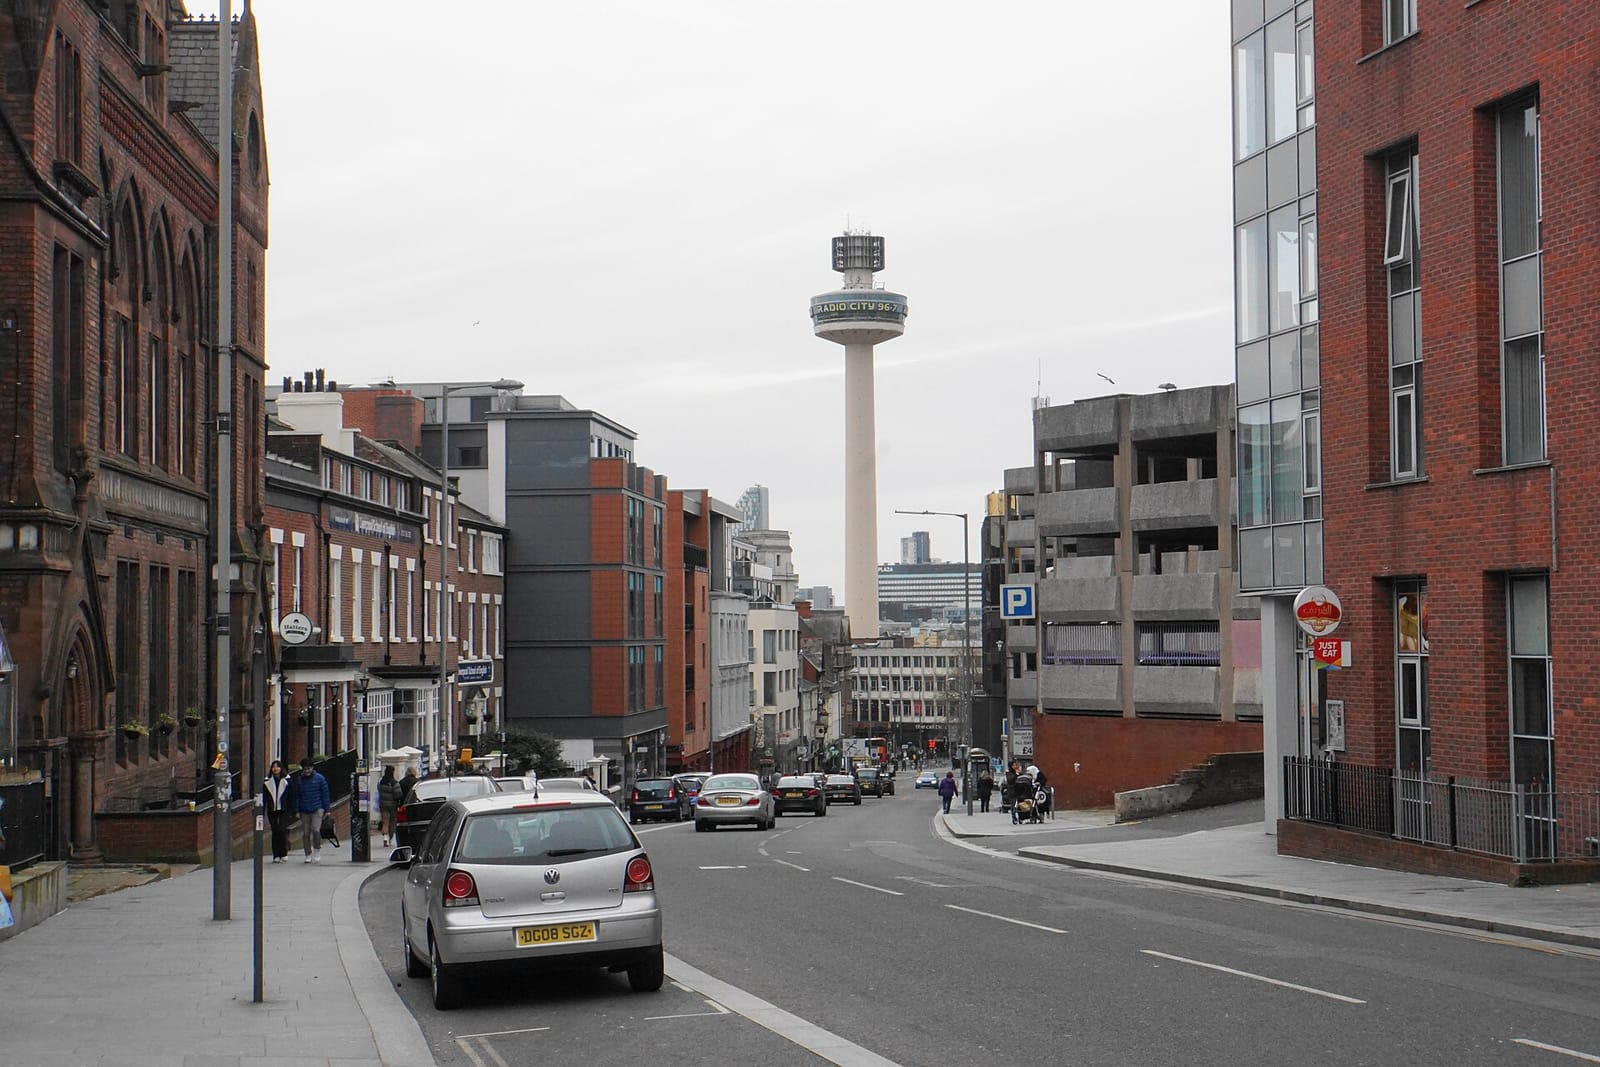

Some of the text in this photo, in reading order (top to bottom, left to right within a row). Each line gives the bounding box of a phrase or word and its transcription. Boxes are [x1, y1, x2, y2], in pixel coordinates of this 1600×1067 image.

[816, 302, 846, 313] RADIO
[849, 302, 875, 311] CITY
[1007, 589, 1027, 615] P
[1318, 642, 1338, 650] JUST
[1322, 649, 1338, 657] EAT
[523, 925, 589, 943] DG08 SGZ
